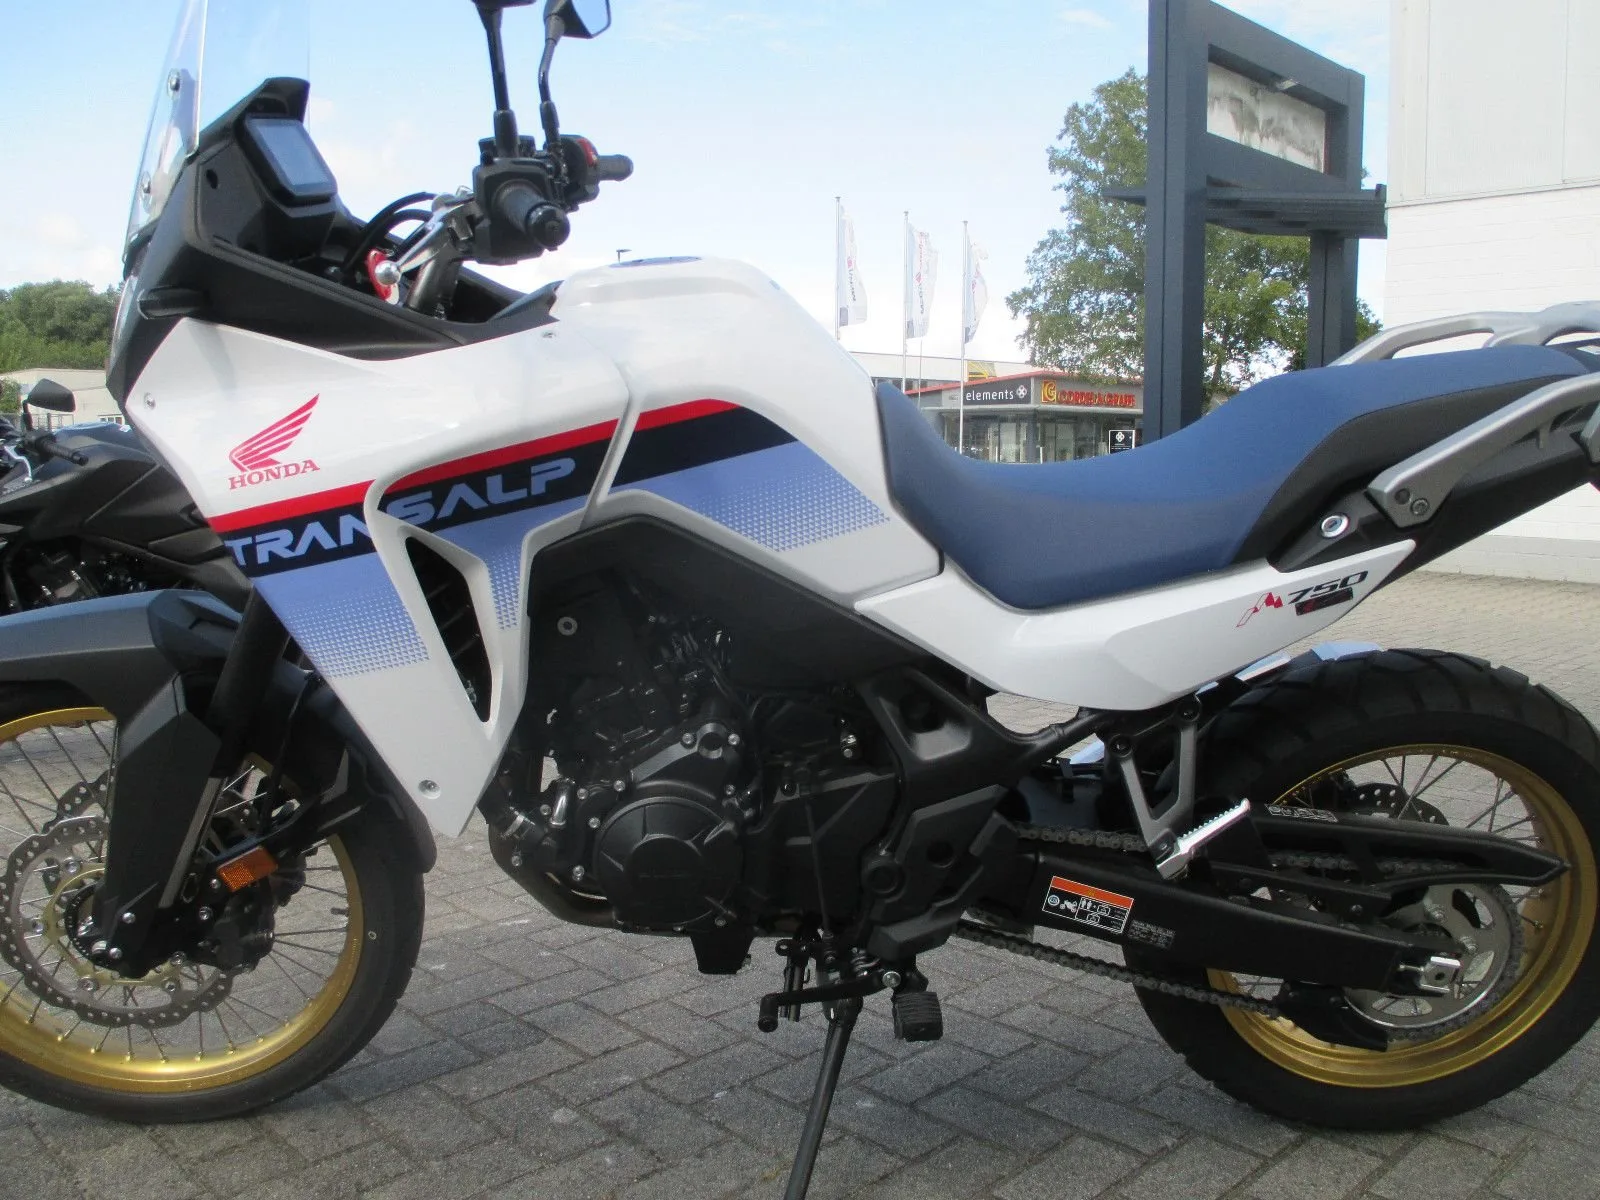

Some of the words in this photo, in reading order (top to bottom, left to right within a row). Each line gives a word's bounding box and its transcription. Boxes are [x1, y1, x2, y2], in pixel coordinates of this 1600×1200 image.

[966, 390, 1014, 401] elements
[228, 458, 321, 490] HONDA
[224, 457, 576, 566] TRANSALP
[1288, 570, 1368, 604] 750
